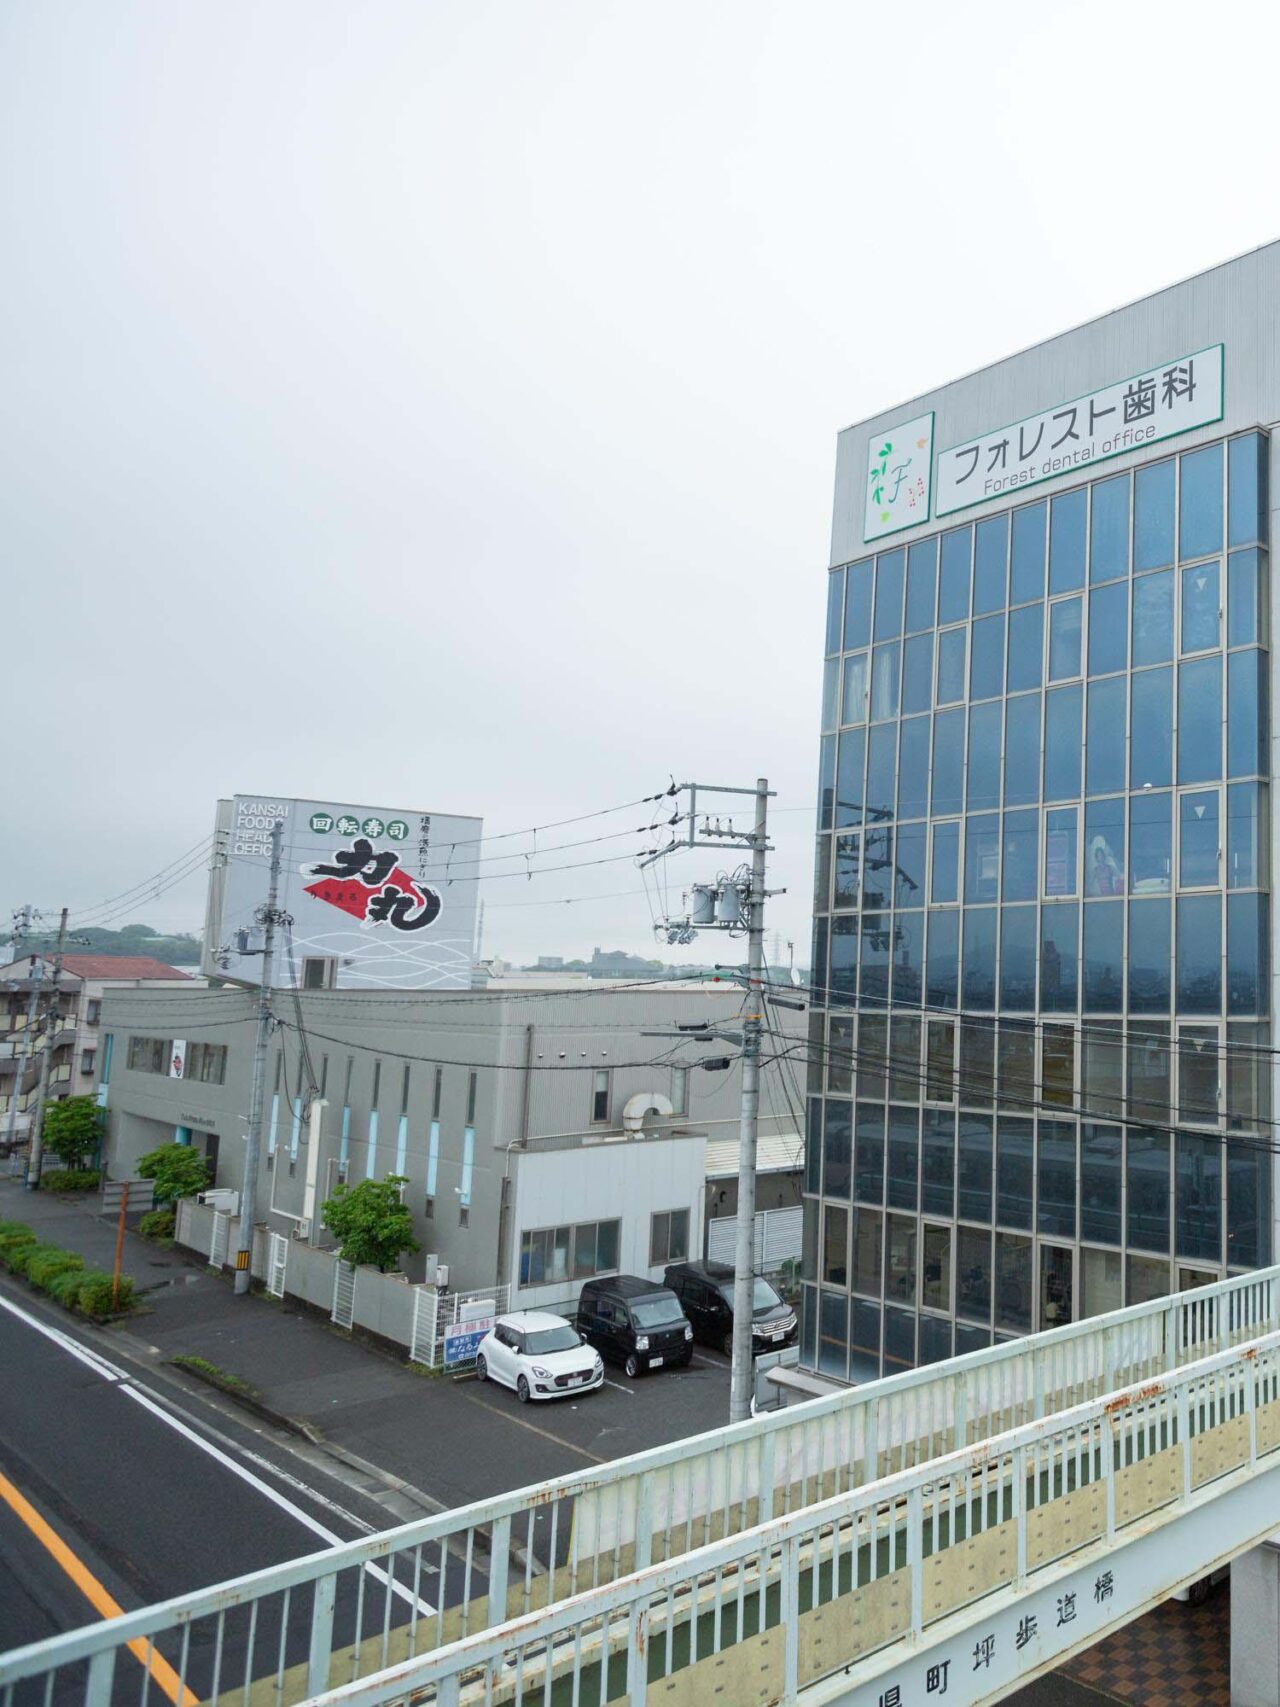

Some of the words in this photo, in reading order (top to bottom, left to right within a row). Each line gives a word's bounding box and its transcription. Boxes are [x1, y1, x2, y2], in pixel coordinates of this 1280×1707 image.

[954, 359, 1197, 486] フォレスト歯科
[984, 465, 1036, 495] Forest
[1041, 446, 1096, 475] dental
[1101, 424, 1156, 454] office
[238, 802, 289, 818] KANSAI
[237, 815, 284, 830] FOOD
[311, 814, 408, 840] 回転寿司
[236, 829, 273, 843] HEAD
[234, 842, 273, 857] OFFIC
